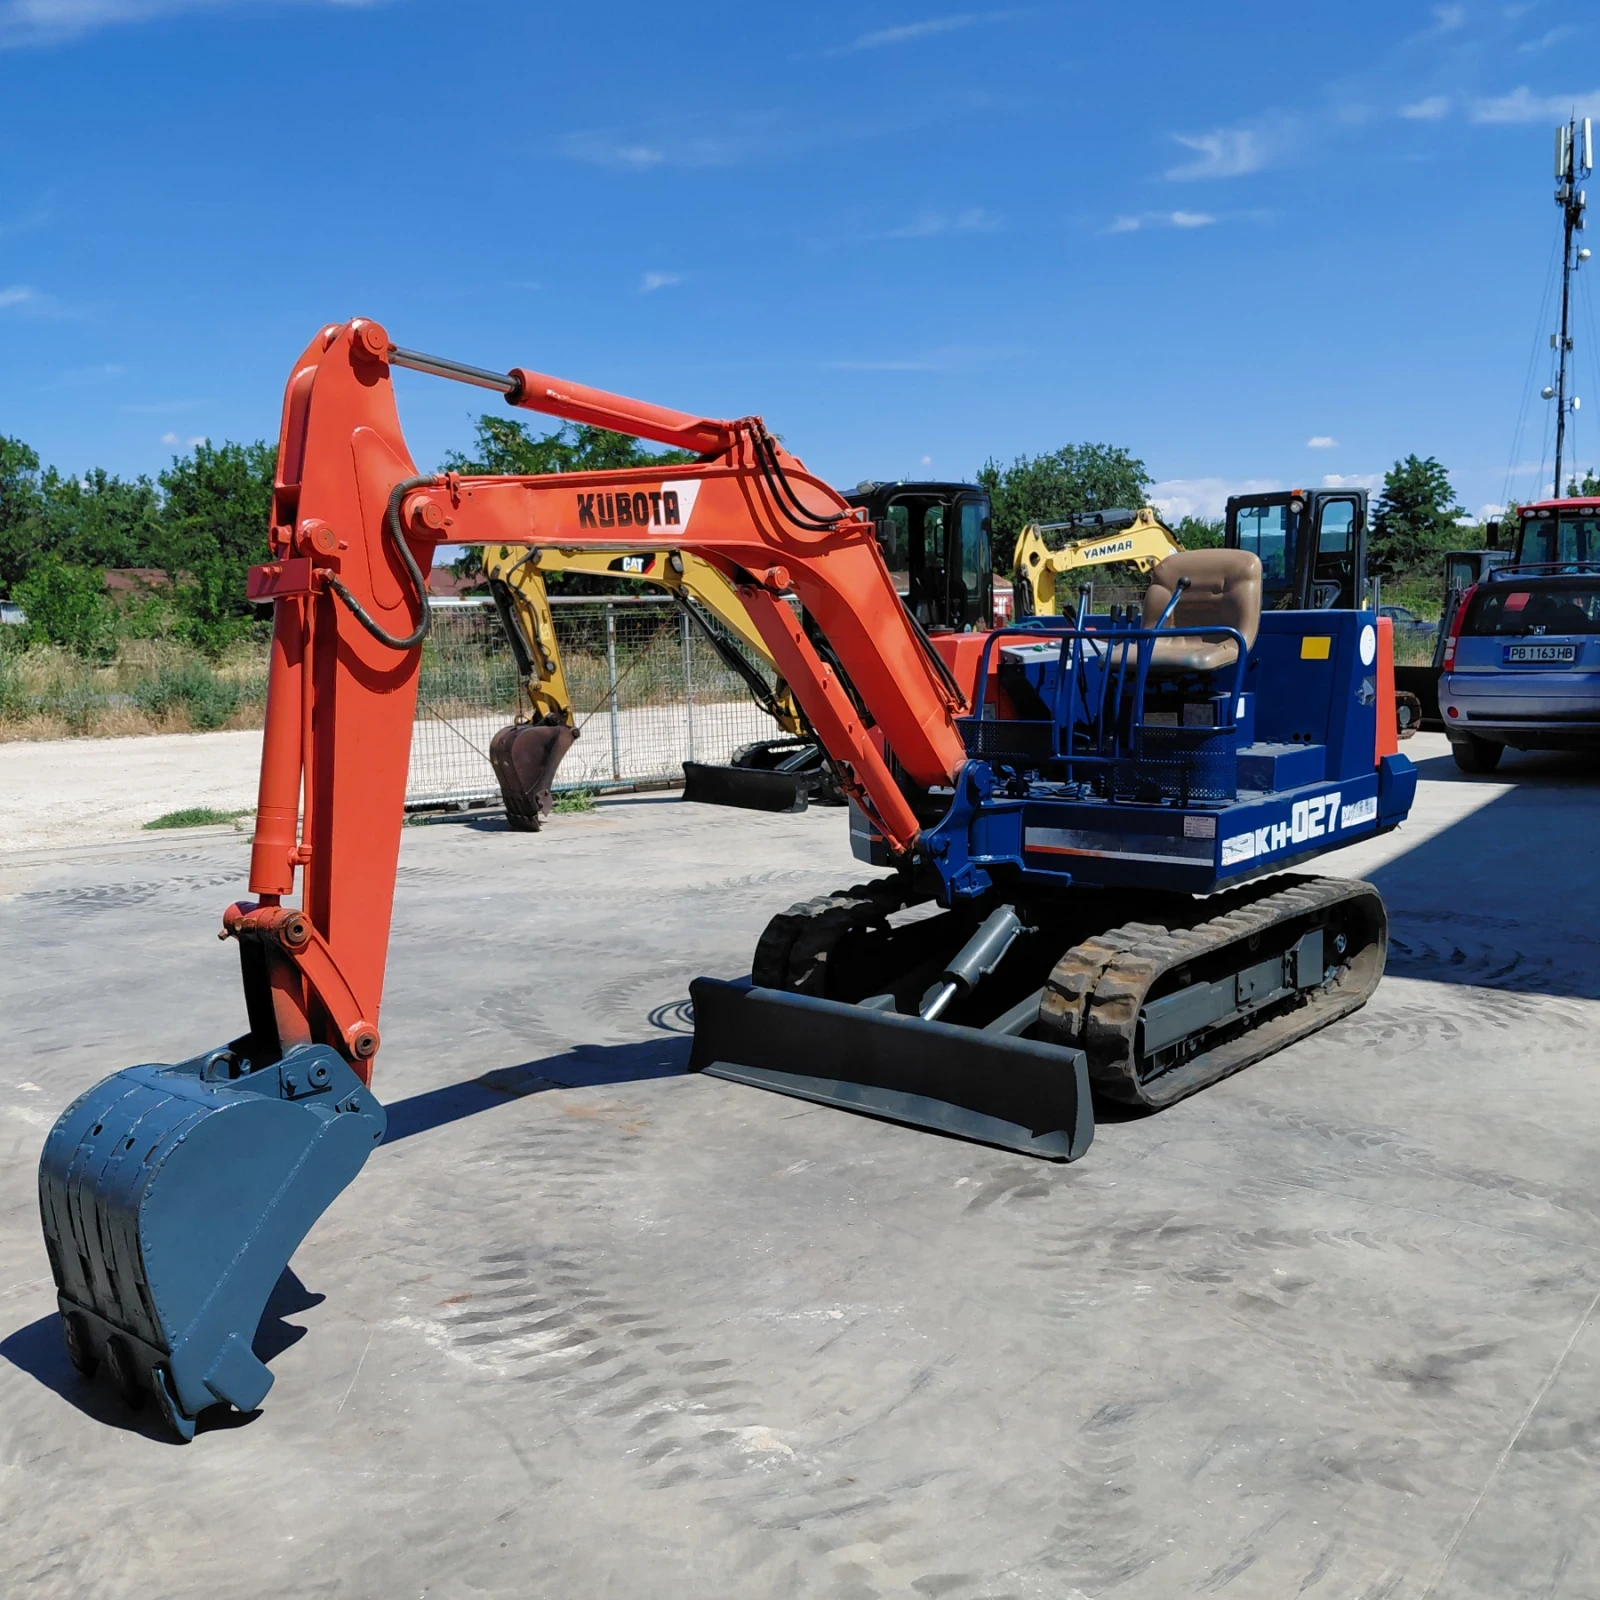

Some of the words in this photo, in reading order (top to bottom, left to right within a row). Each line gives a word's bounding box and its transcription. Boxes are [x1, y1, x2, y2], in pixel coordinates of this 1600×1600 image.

[577, 490, 681, 529] KUBOTA
[1083, 540, 1132, 559] YANMAR
[622, 556, 644, 573] CAT
[1511, 648, 1526, 659] PB
[1530, 648, 1556, 659] 1163
[1557, 647, 1573, 659] HB
[1255, 791, 1341, 856] KH-027
